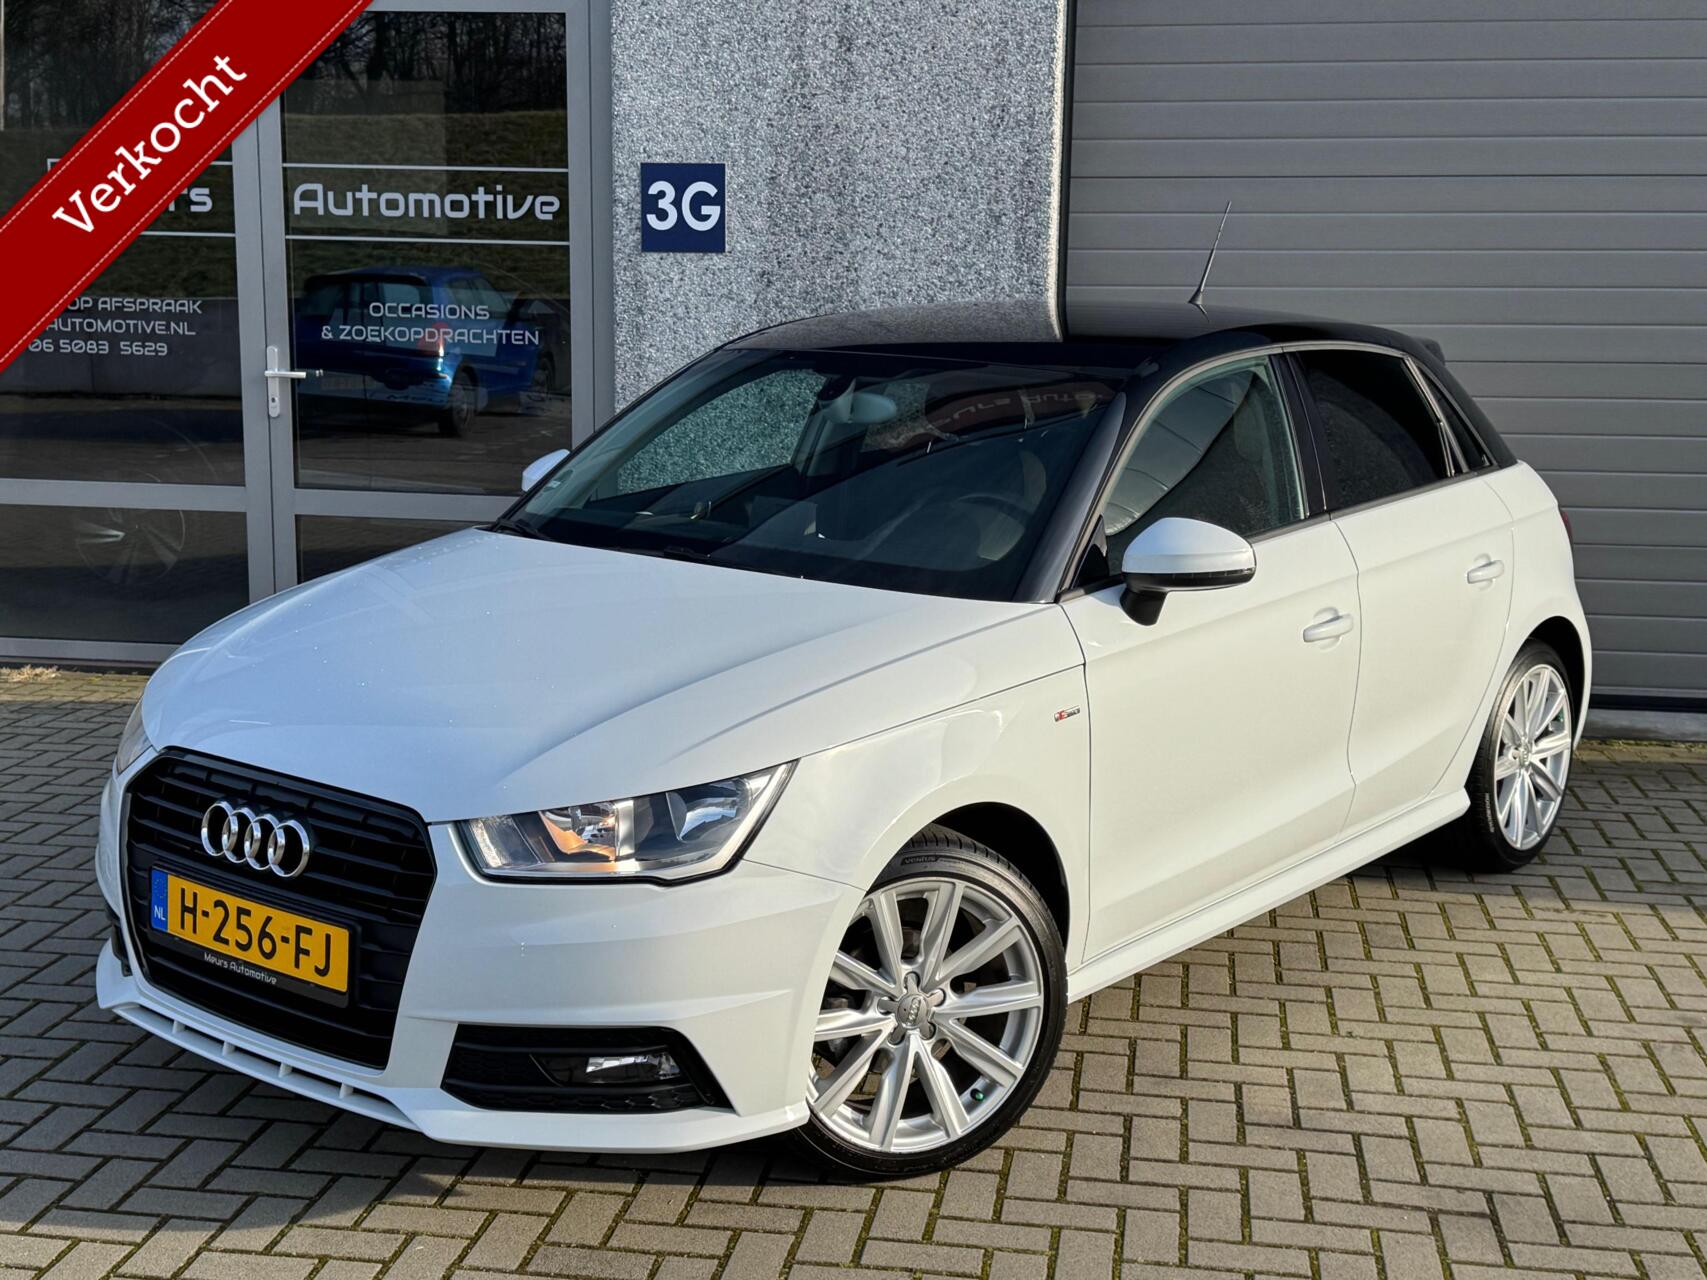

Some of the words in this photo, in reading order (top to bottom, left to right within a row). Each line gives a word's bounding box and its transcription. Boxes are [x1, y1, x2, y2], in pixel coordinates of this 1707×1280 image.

[293, 183, 560, 220] Automotive
[646, 180, 721, 231] 3G
[98, 298, 202, 314] AFSPRAAK
[369, 302, 490, 320] OCCASIONS
[321, 326, 333, 339] &
[339, 325, 539, 345] ZOEKOPDRACHTEN
[59, 339, 109, 354] 5083
[119, 341, 168, 356] 5629
[153, 905, 166, 921] NL
[180, 887, 331, 977] H-256-FJ
[204, 952, 228, 969] Meurs
[229, 961, 278, 985] Automotive
